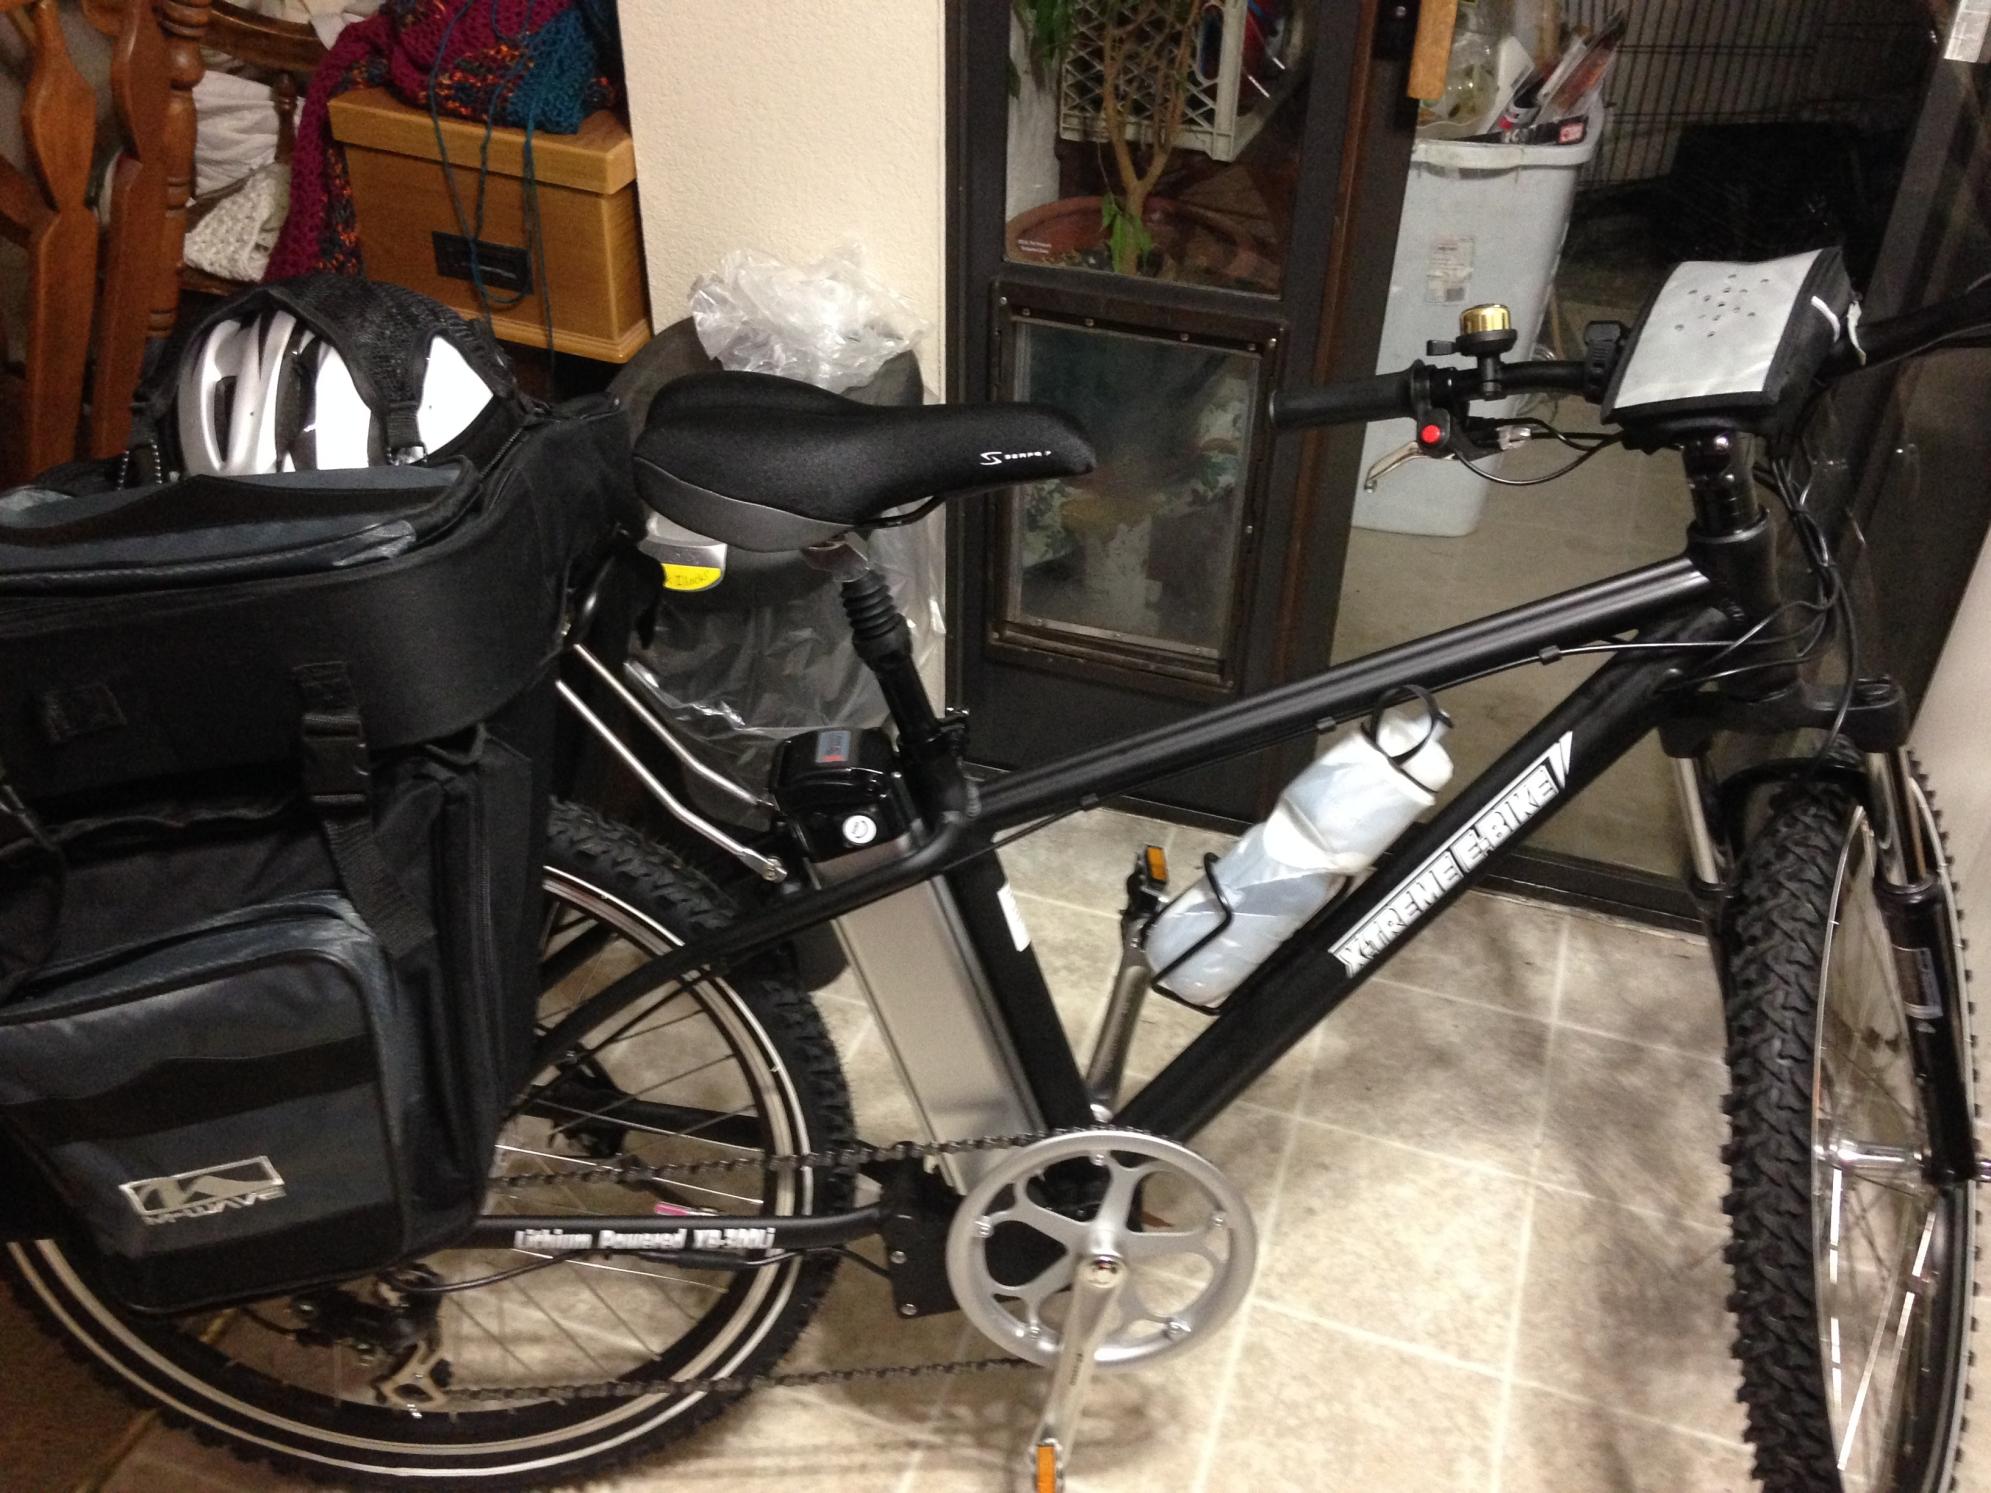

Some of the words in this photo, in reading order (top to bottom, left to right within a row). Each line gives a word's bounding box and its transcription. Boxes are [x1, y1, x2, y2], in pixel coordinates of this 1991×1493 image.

[1450, 763, 1560, 874] E-BIKE
[514, 1228, 593, 1250] Lithium
[597, 1228, 688, 1250] Powered
